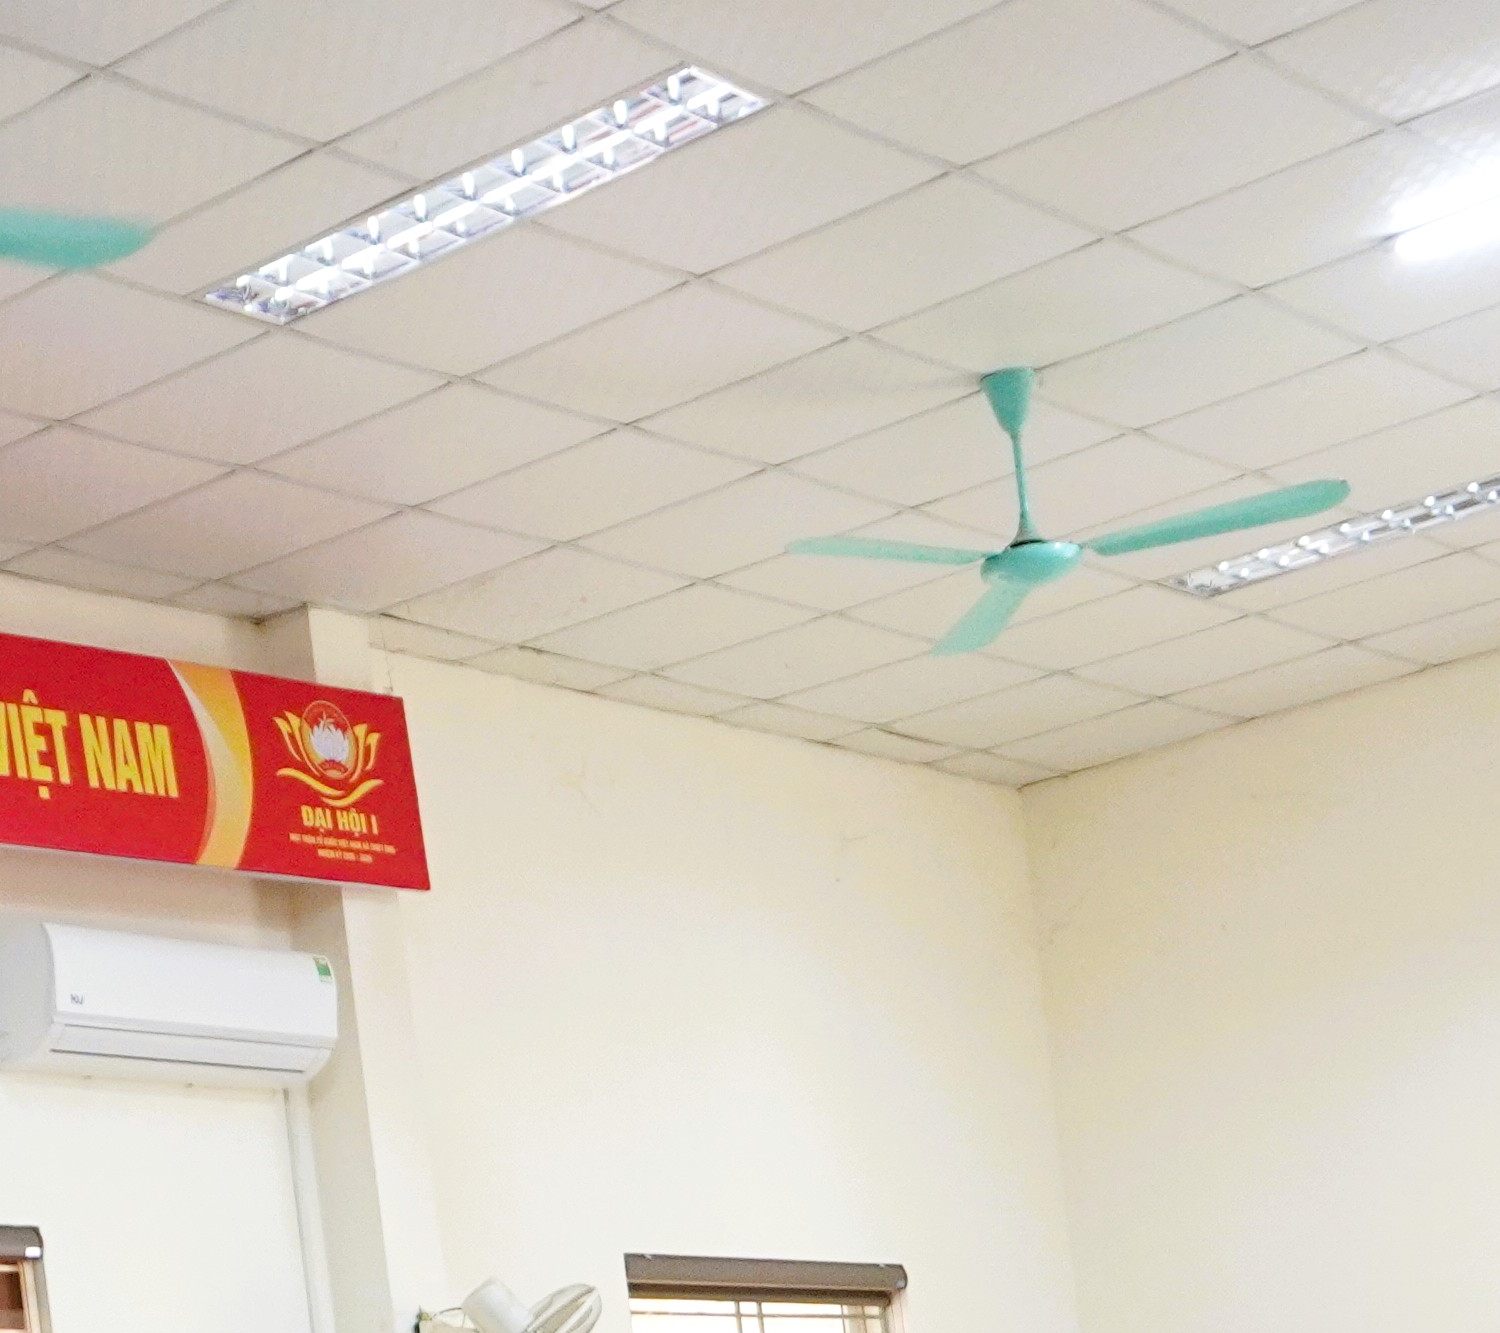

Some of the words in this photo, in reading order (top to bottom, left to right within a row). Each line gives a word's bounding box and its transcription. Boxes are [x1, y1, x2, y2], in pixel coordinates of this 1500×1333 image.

[79, 714, 180, 798] NAM
[301, 804, 333, 833] ĐẠI
[336, 807, 368, 838] HỘI
